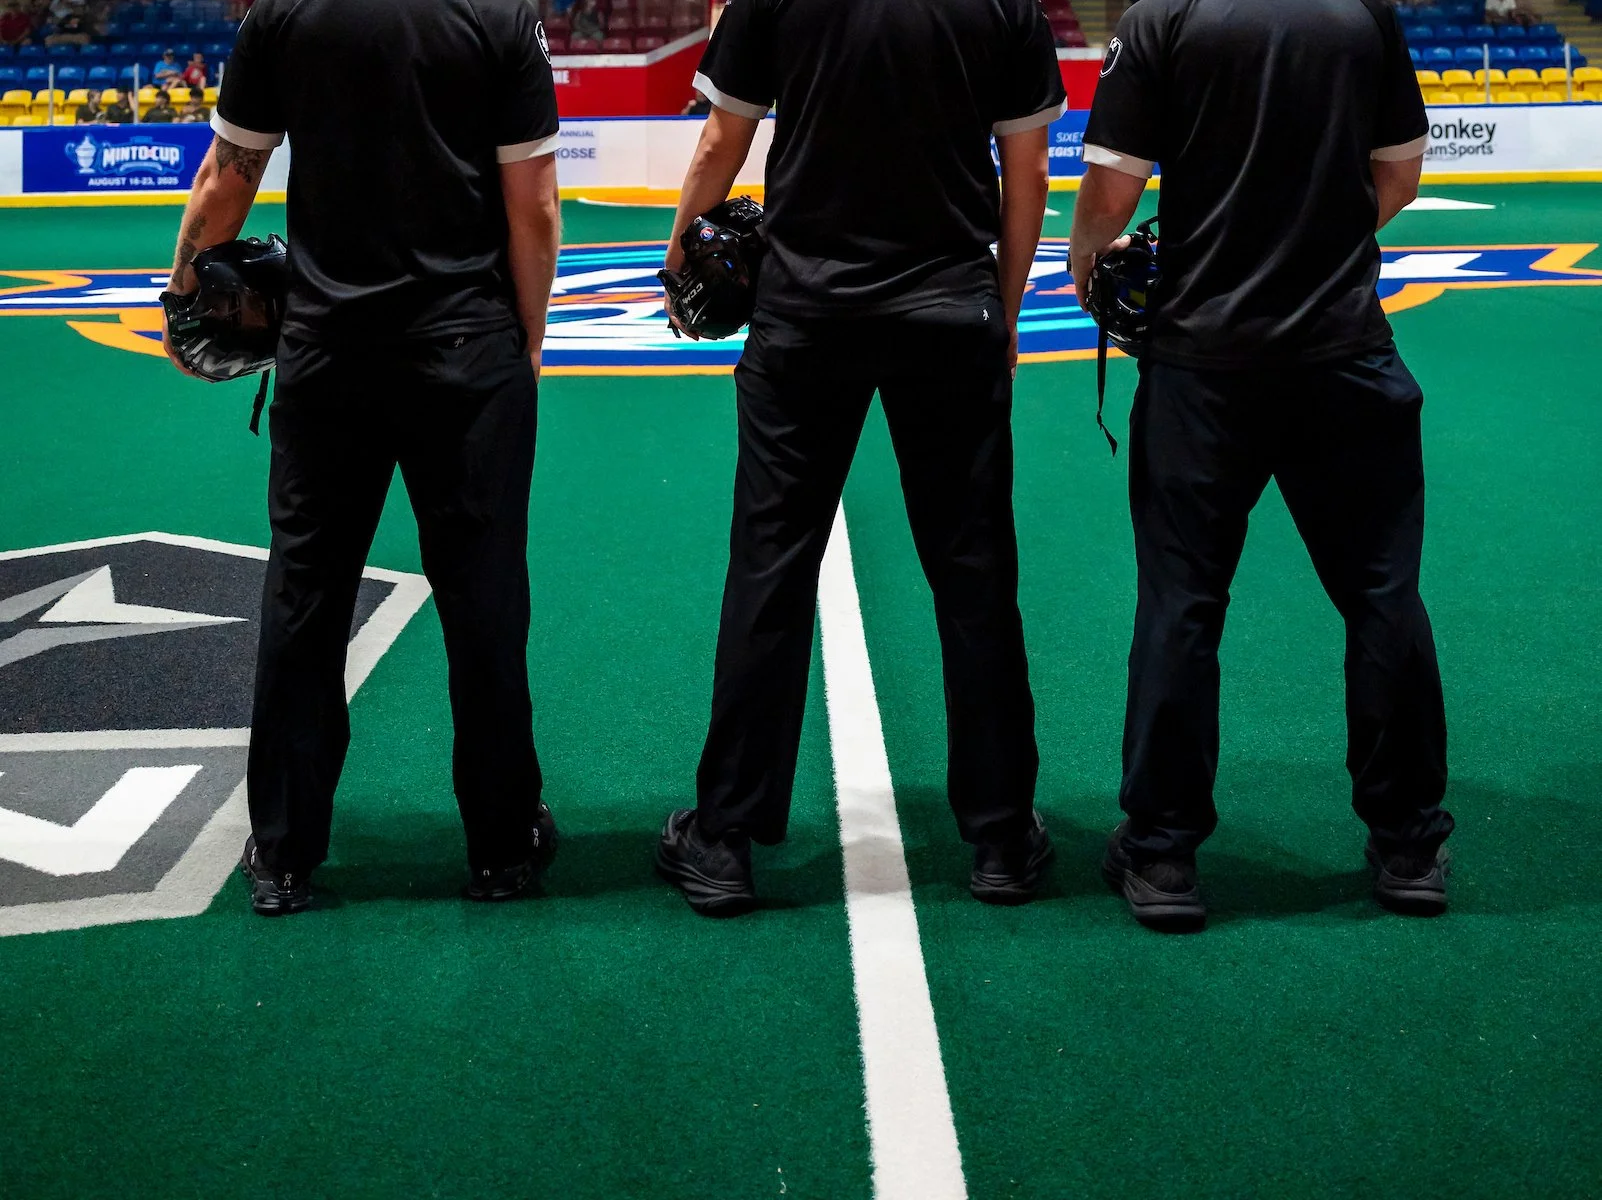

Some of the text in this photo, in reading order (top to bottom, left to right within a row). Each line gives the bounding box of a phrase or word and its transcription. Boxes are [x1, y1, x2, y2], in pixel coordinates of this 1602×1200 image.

[1430, 118, 1496, 143] onkey
[102, 146, 148, 167] MINTO
[88, 177, 127, 187] AUGUST
[157, 176, 179, 185] 2025
[682, 282, 703, 304] CCM
